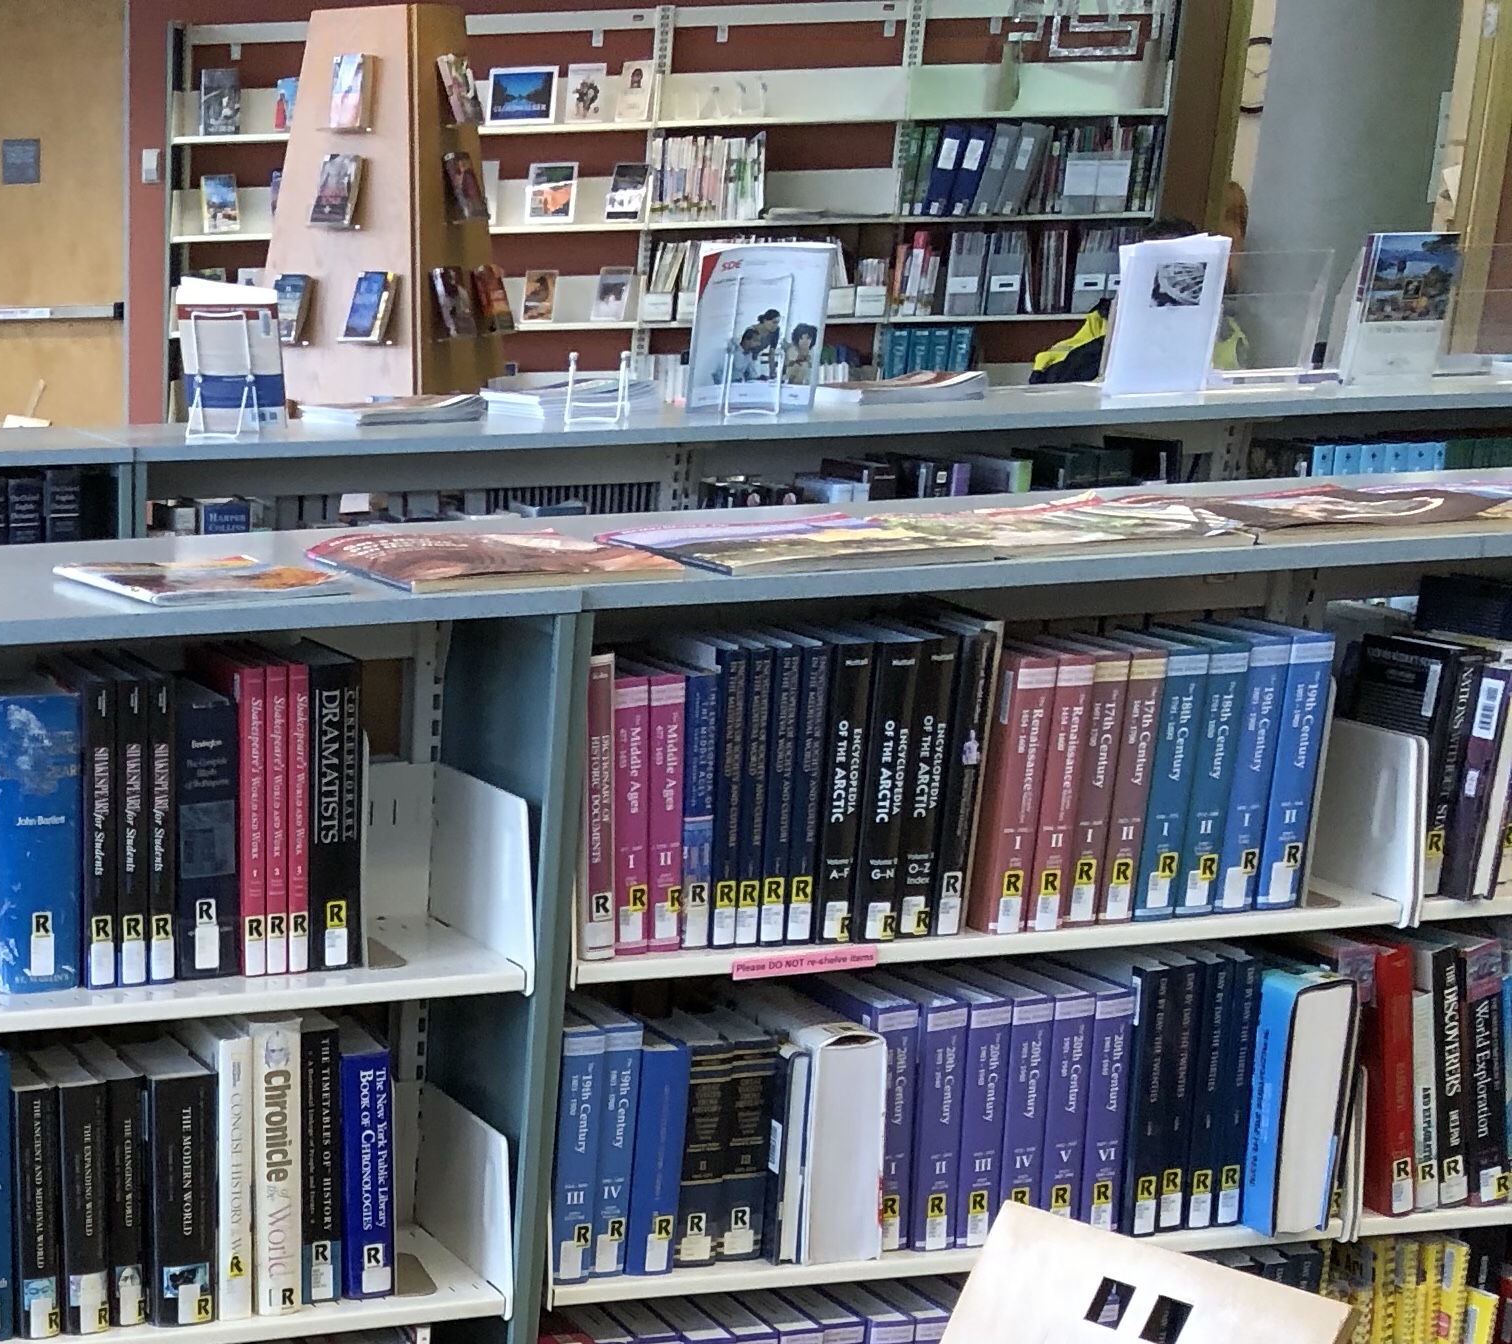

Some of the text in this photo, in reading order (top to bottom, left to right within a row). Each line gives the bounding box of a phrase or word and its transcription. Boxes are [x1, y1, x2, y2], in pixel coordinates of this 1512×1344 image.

[1024, 708, 1044, 791] Renaissance
[1093, 703, 1116, 789] 17th Century
[1168, 696, 1193, 781] 18th Century
[1294, 684, 1319, 769] 19th Century
[321, 690, 340, 844] DRAMATISTS
[627, 728, 642, 814] Middle Ages
[831, 721, 849, 823] OF THE ARCTIC
[847, 729, 862, 815] ENCYCLOPEDIA
[16, 817, 36, 827] John
[94, 832, 105, 876] Students
[592, 795, 600, 864] DOCUMENTS
[1287, 845, 1300, 863] R
[628, 855, 634, 868] I
[595, 895, 609, 913] R
[737, 954, 874, 972] Please DO NOT re-shelve items
[321, 1039, 330, 1061] THE
[1445, 986, 1461, 1097] DISCOVERERS
[1474, 1000, 1491, 1138] World Exploration
[321, 1066, 331, 1146] TIMETABLES
[182, 1107, 192, 1235] THE MODERN WORLD
[376, 1067, 388, 1229] The New York Public Library
[322, 1177, 332, 1232] HISTORY
[567, 1191, 584, 1204] III
[603, 1186, 621, 1199] IV
[268, 1205, 295, 1278] World
[366, 1246, 381, 1265] R
